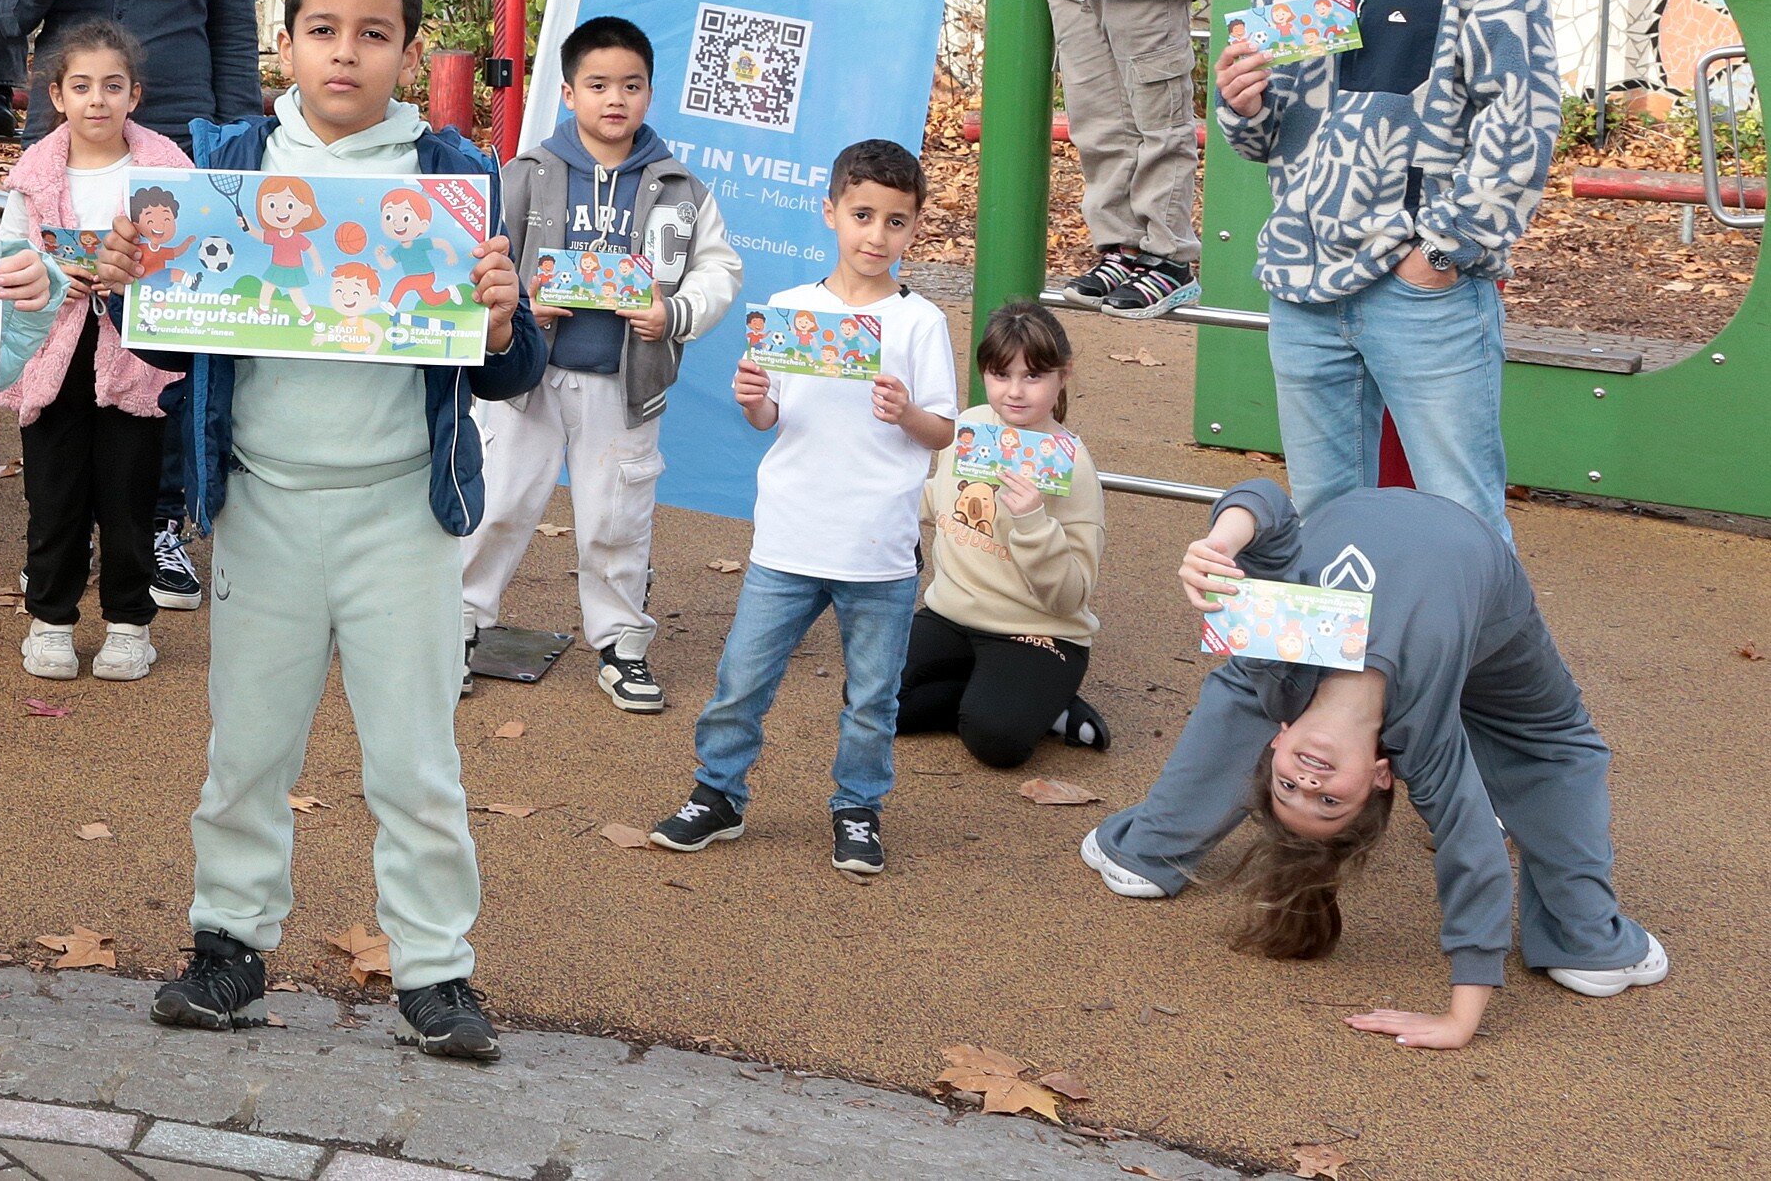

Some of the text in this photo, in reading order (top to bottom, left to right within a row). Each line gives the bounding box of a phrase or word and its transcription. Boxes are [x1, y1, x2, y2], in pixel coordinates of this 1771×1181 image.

[662, 138, 830, 190] IT IN VIELF
[435, 183, 484, 232] 2025/2026
[448, 180, 486, 218] Schuljahr
[721, 180, 740, 199] fit
[761, 187, 818, 213] Macht
[566, 205, 631, 236] ARI
[569, 241, 589, 250] JUST
[139, 284, 241, 306] Bochumer
[137, 302, 290, 326] Sportgutschein
[328, 325, 358, 334] STADT
[328, 334, 371, 344] BOCHUM
[410, 328, 481, 338] STADTSPORTBUND
[410, 336, 442, 345] Bochum
[936, 510, 1011, 562] apybara
